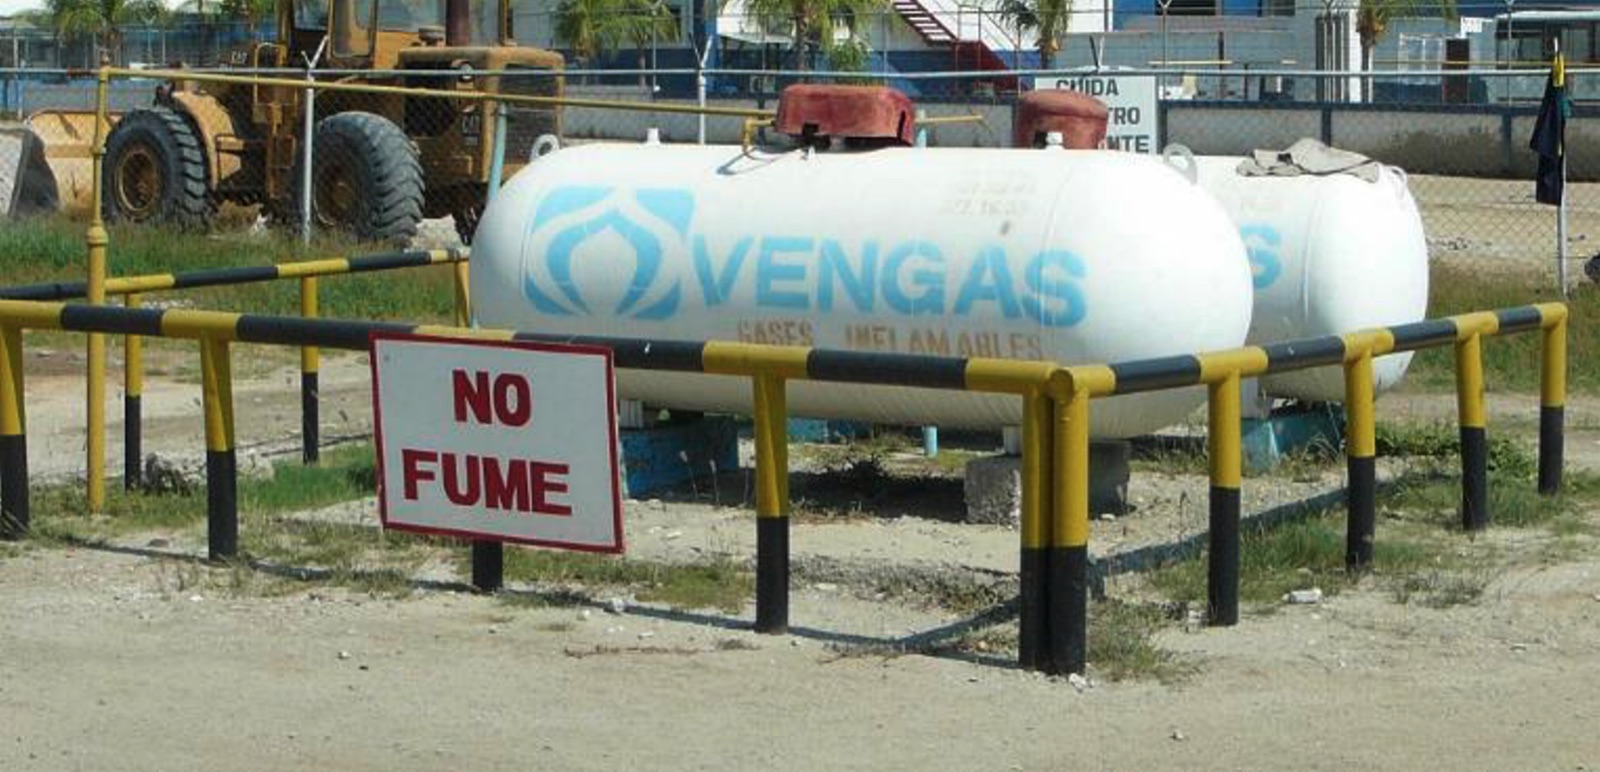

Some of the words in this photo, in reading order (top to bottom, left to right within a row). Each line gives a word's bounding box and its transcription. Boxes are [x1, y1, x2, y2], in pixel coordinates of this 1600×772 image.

[691, 233, 1088, 328] VENGAS
[452, 369, 531, 427] NO
[402, 449, 572, 516] FUME
